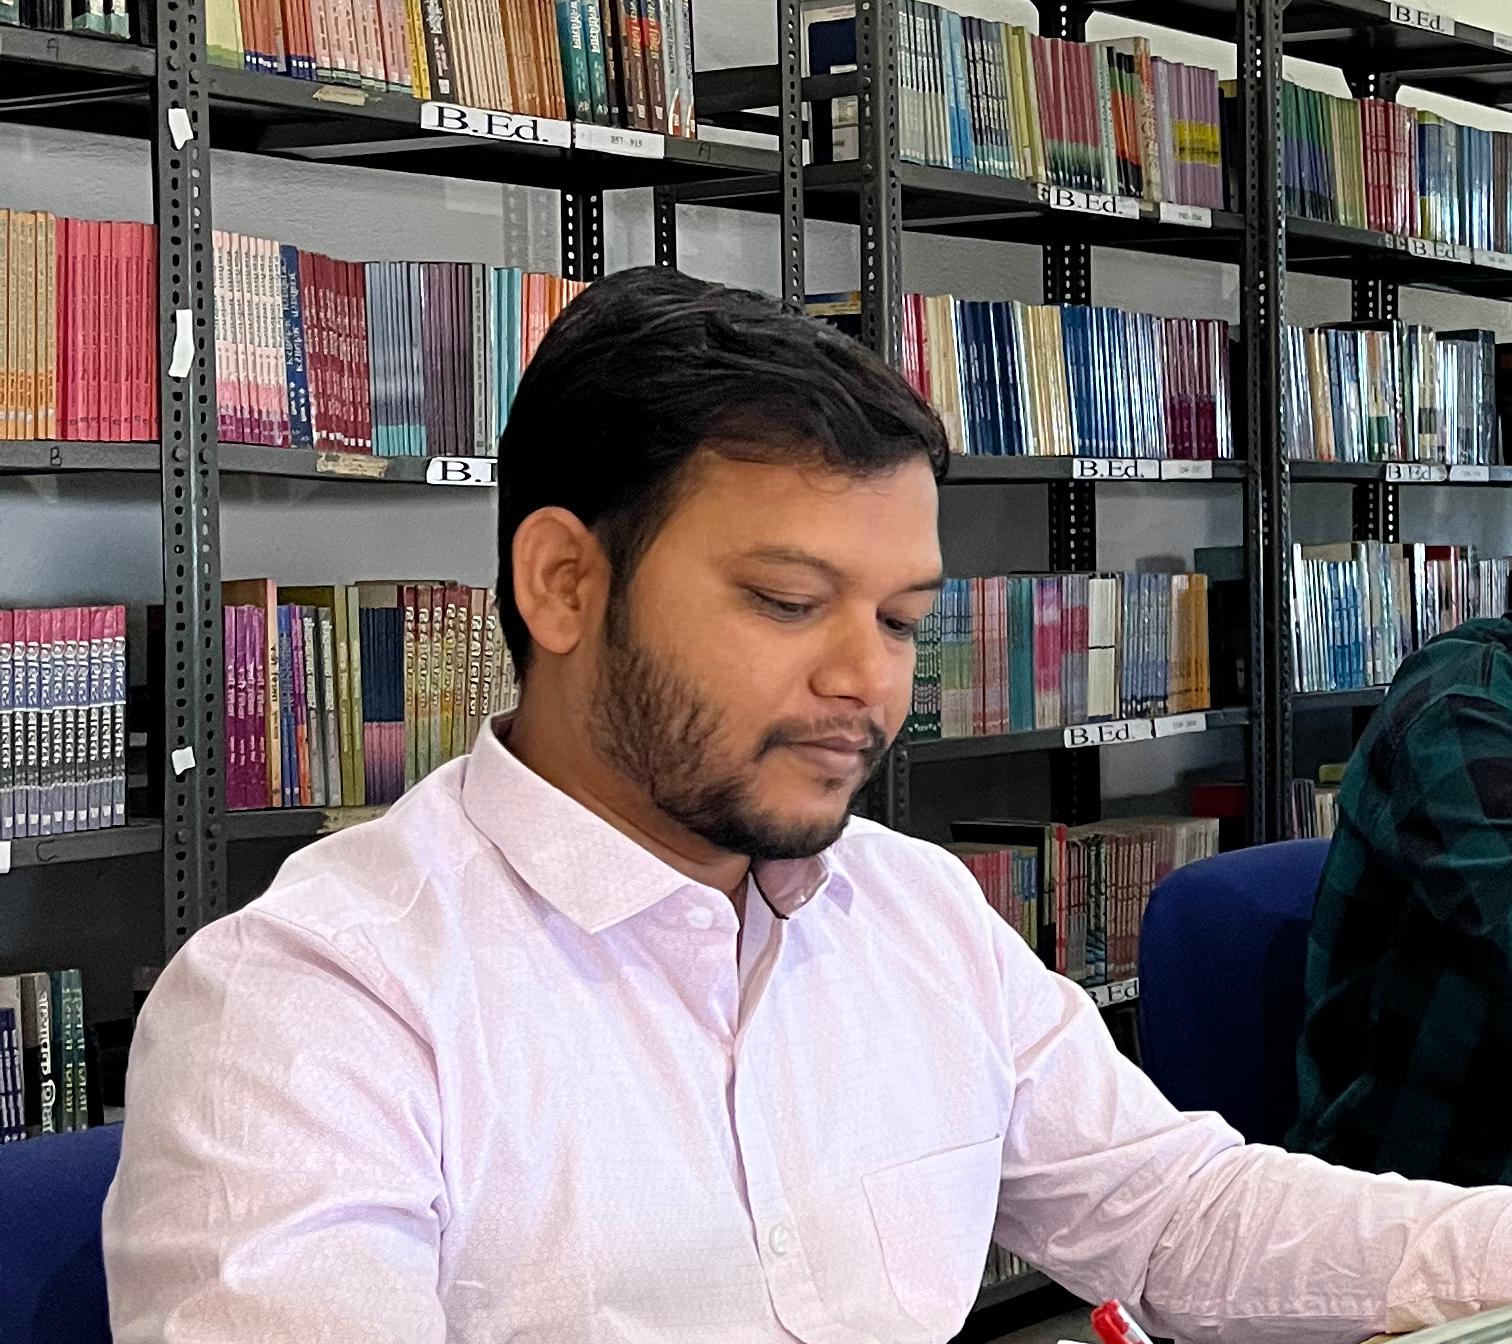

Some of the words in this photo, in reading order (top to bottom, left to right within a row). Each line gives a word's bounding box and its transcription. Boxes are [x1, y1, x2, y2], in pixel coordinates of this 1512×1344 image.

[1395, 5, 1445, 31] B.Ed.
[432, 107, 550, 143] B.Ed.
[1055, 191, 1123, 215] B.Ed.
[1079, 460, 1145, 479] B.Ed.
[1069, 724, 1135, 745] B.Ed.
